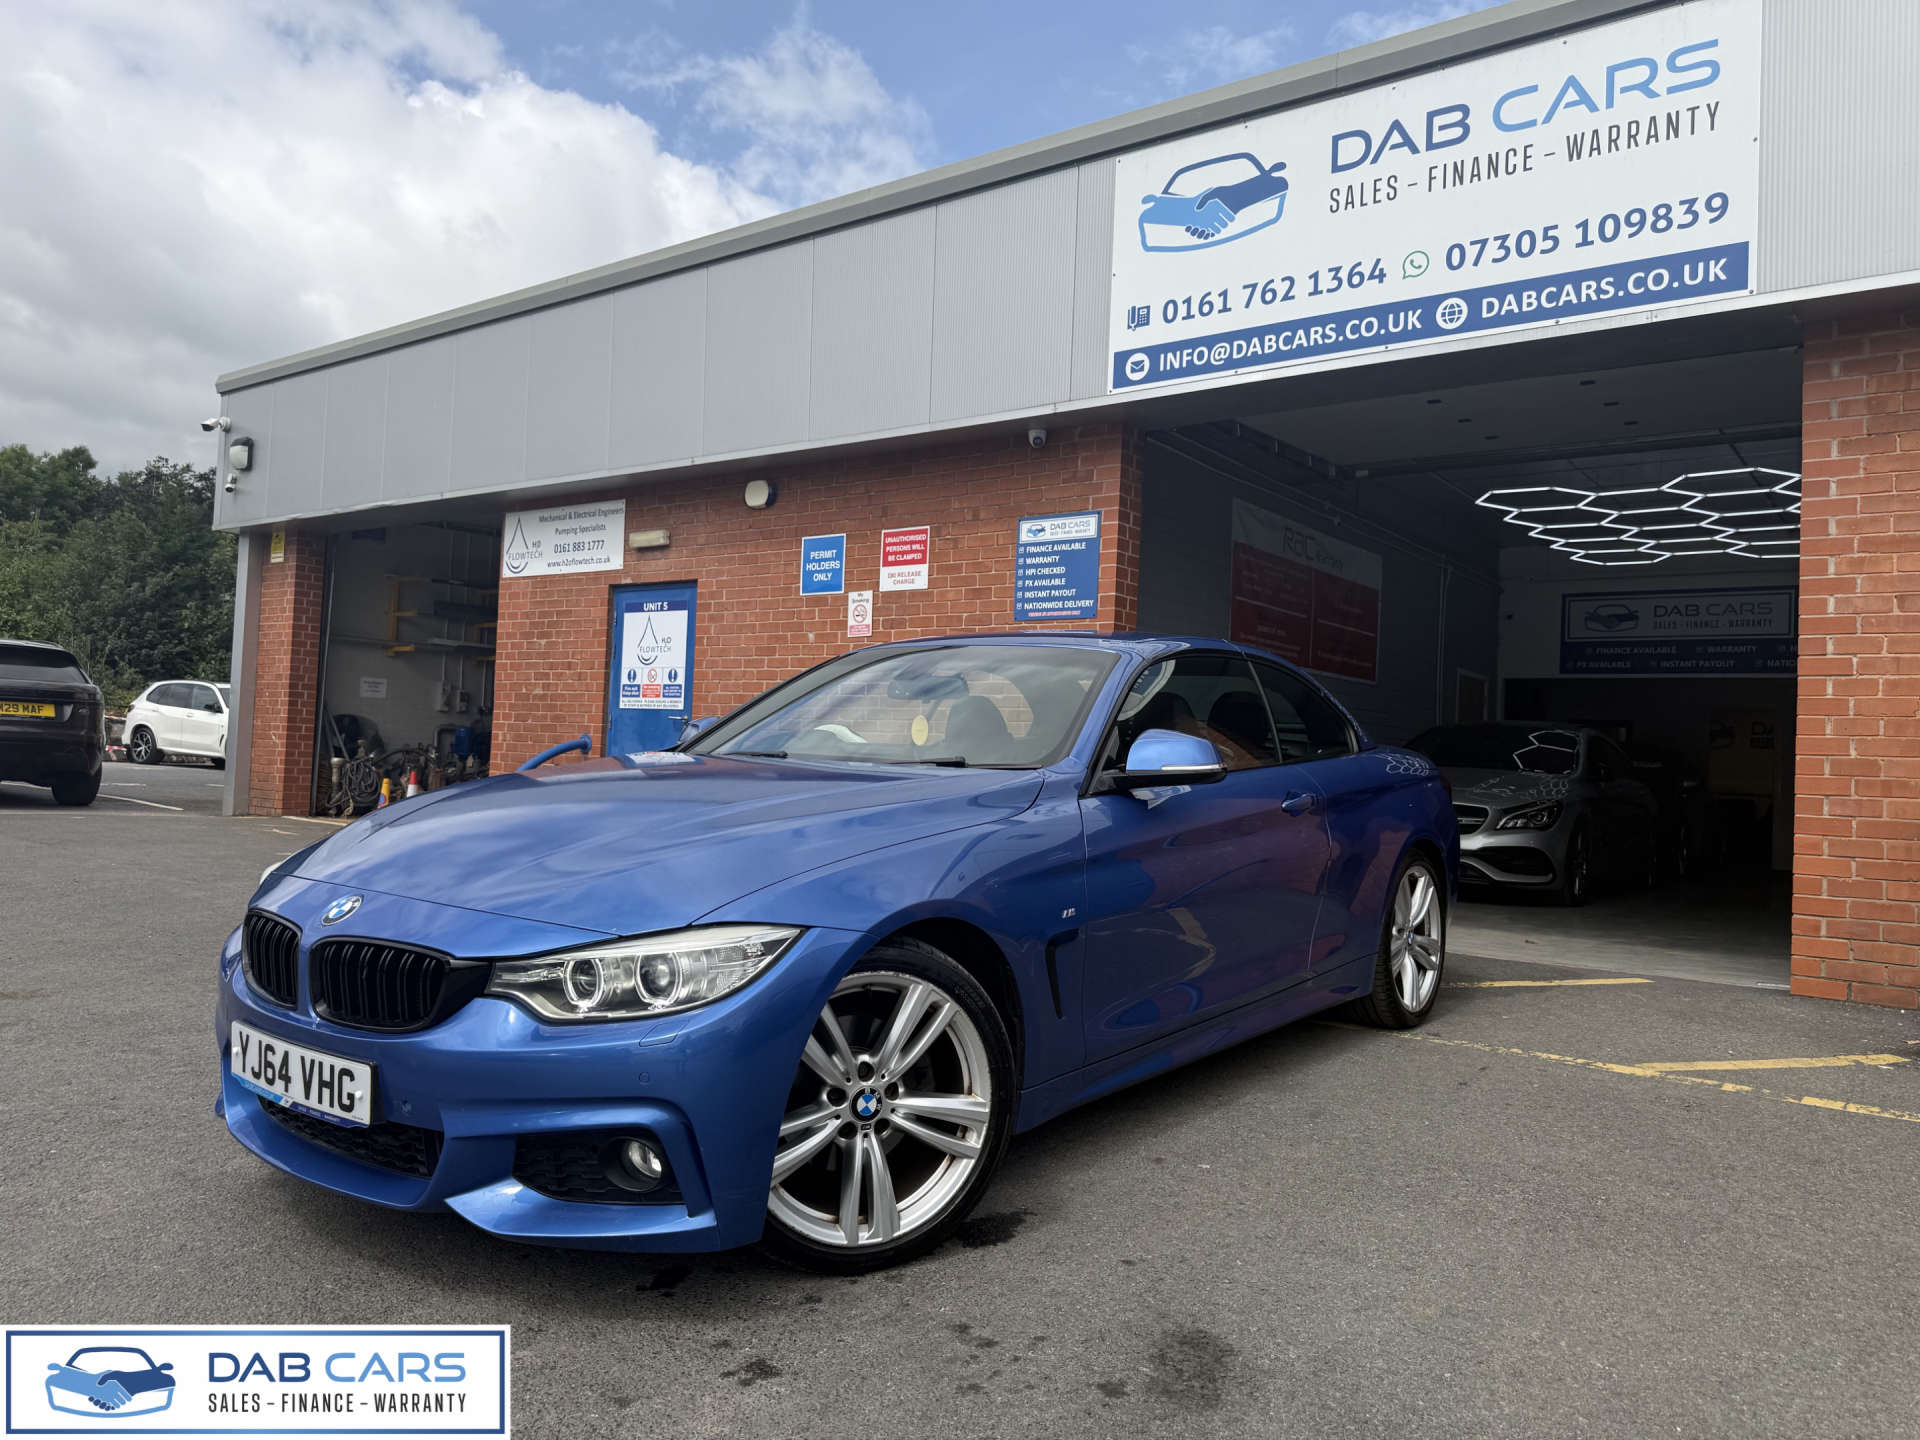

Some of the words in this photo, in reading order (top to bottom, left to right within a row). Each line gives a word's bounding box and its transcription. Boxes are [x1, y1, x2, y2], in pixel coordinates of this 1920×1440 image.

[1331, 103, 1471, 174] DAB
[1492, 39, 1721, 133] CARS
[1329, 175, 1398, 213] SALES
[1428, 144, 1534, 192] FINANCE
[1566, 101, 1720, 162] WARRANTY
[1445, 224, 1560, 271] 07305
[1575, 191, 1730, 248] 109839
[1162, 288, 1232, 324] 0161
[1242, 276, 1296, 309] 762
[1307, 258, 1387, 297] 1364
[1481, 258, 1727, 319] DABCARS.CO.UK
[1159, 309, 1422, 372] INFO@DABCARS.CO.UK
[539, 512, 567, 522] Mechanical
[574, 510, 598, 519] Electrical
[555, 527, 578, 536] Pumping
[885, 534, 926, 543] UNAUTHORISED
[554, 543, 571, 554] 0161
[573, 541, 585, 552] 883
[588, 540, 605, 551] 1777
[1026, 545, 1052, 553] FINANCE
[1053, 542, 1086, 551] AVAILABLE
[508, 551, 543, 561] FLOWTECH
[810, 550, 837, 559] PERMIT
[1025, 555, 1059, 564] WARRANTY
[806, 561, 840, 571] HOLDERS
[1025, 568, 1036, 576] HPI
[1037, 567, 1066, 575] CHECKED
[813, 572, 832, 582] ONLY
[1034, 578, 1066, 586] AVAILABLE
[1024, 590, 1050, 598] INSTANT
[1051, 589, 1076, 597] PAYOUT
[643, 602, 662, 611] UNIT
[663, 602, 668, 610] 5
[1024, 601, 1063, 610] NATIONWIDE
[1064, 600, 1094, 608] DELIVERY
[1653, 603, 1700, 618] DAB
[1705, 601, 1773, 616] CARS
[639, 645, 672, 654] FLOWTECH
[22, 703, 44, 714] MAF
[239, 1031, 292, 1093] YJ64
[300, 1055, 356, 1113] VHG
